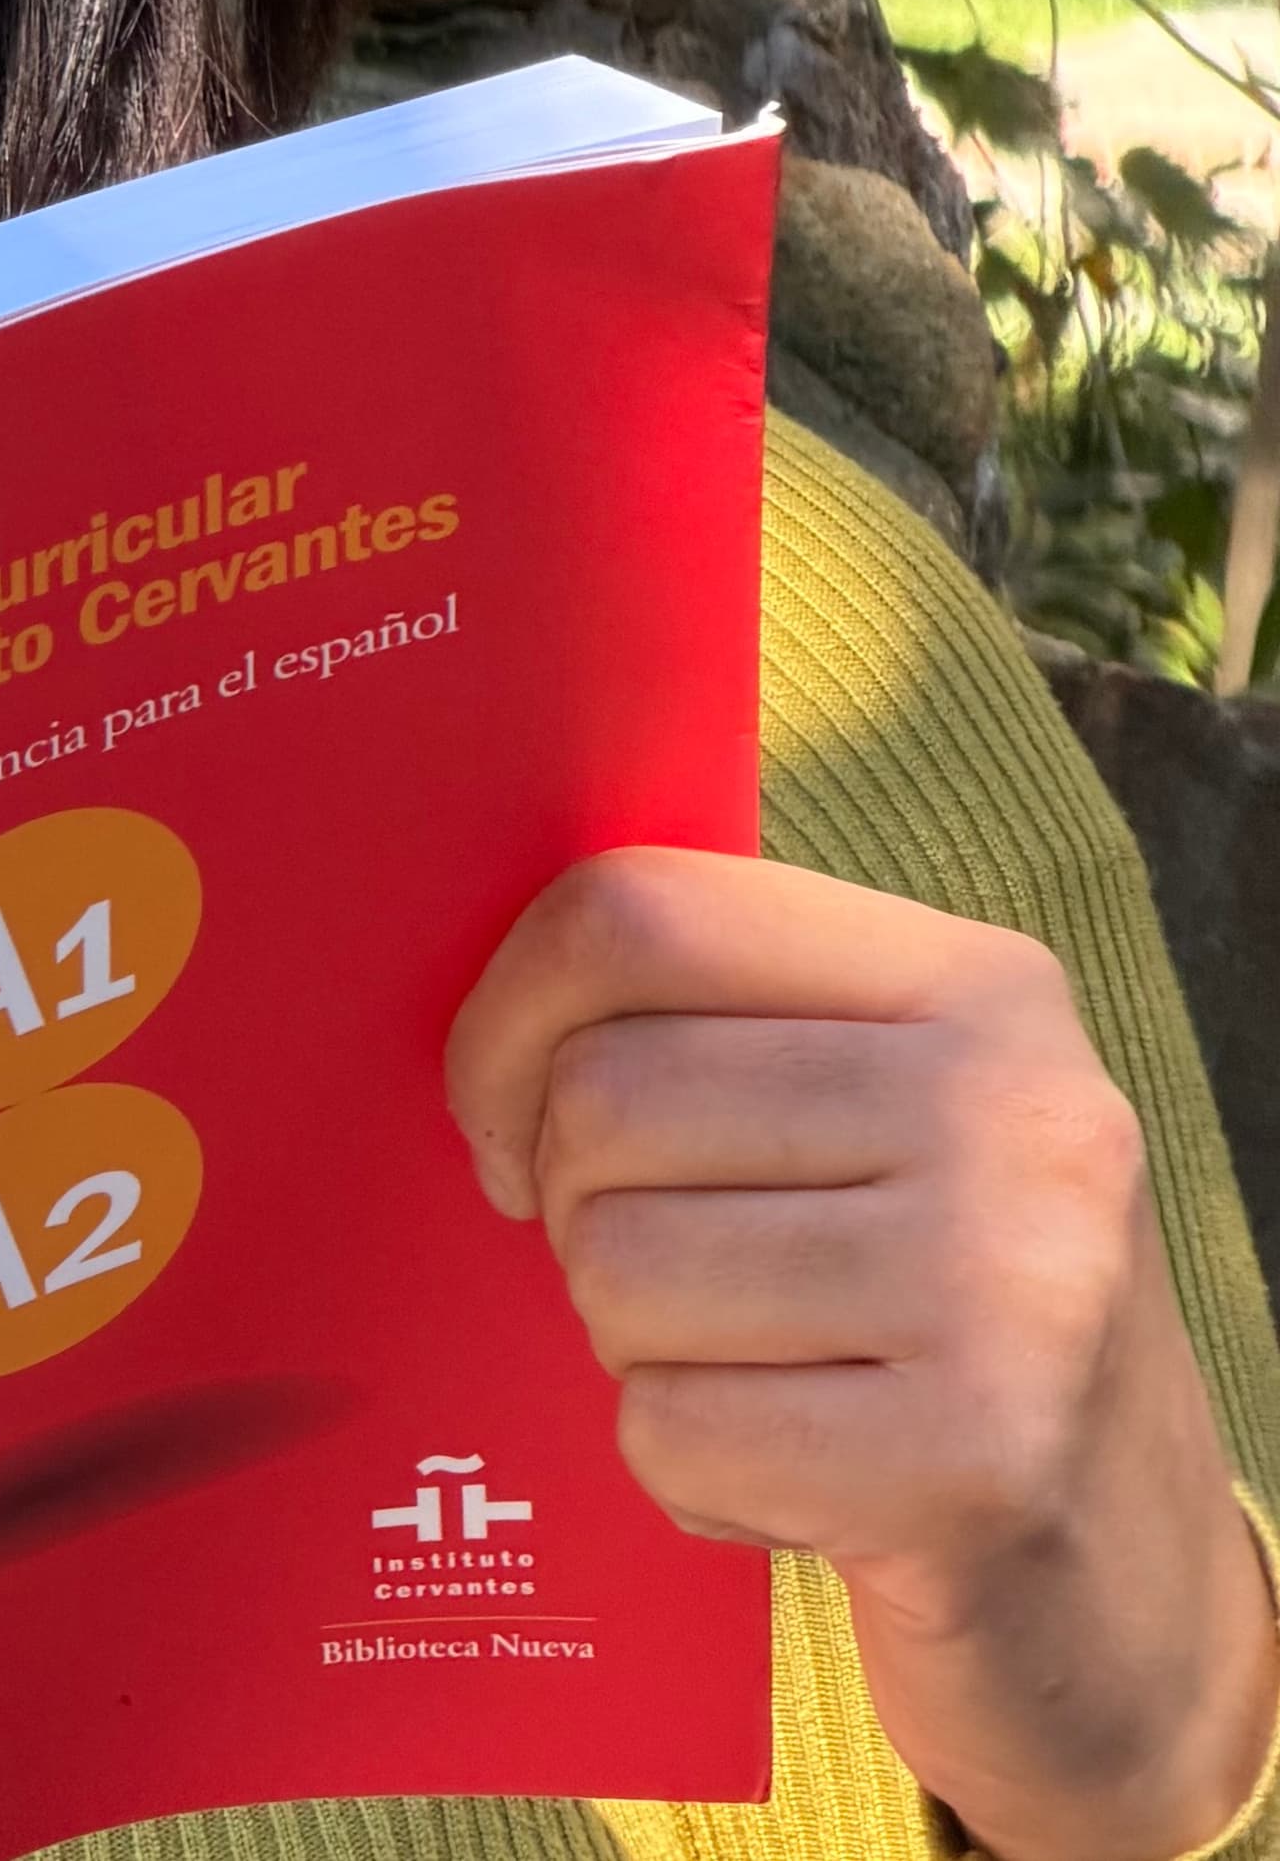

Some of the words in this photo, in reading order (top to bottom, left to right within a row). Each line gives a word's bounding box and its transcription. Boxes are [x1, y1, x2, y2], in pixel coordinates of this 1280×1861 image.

[79, 494, 459, 645] Cervantes
[103, 685, 201, 752] para
[219, 651, 256, 697] el
[274, 593, 458, 679] español
[374, 1551, 533, 1572] Instituto
[375, 1579, 534, 1599] Cervantes
[322, 1637, 479, 1664] Biblioteca
[492, 1634, 594, 1658] Nueva
